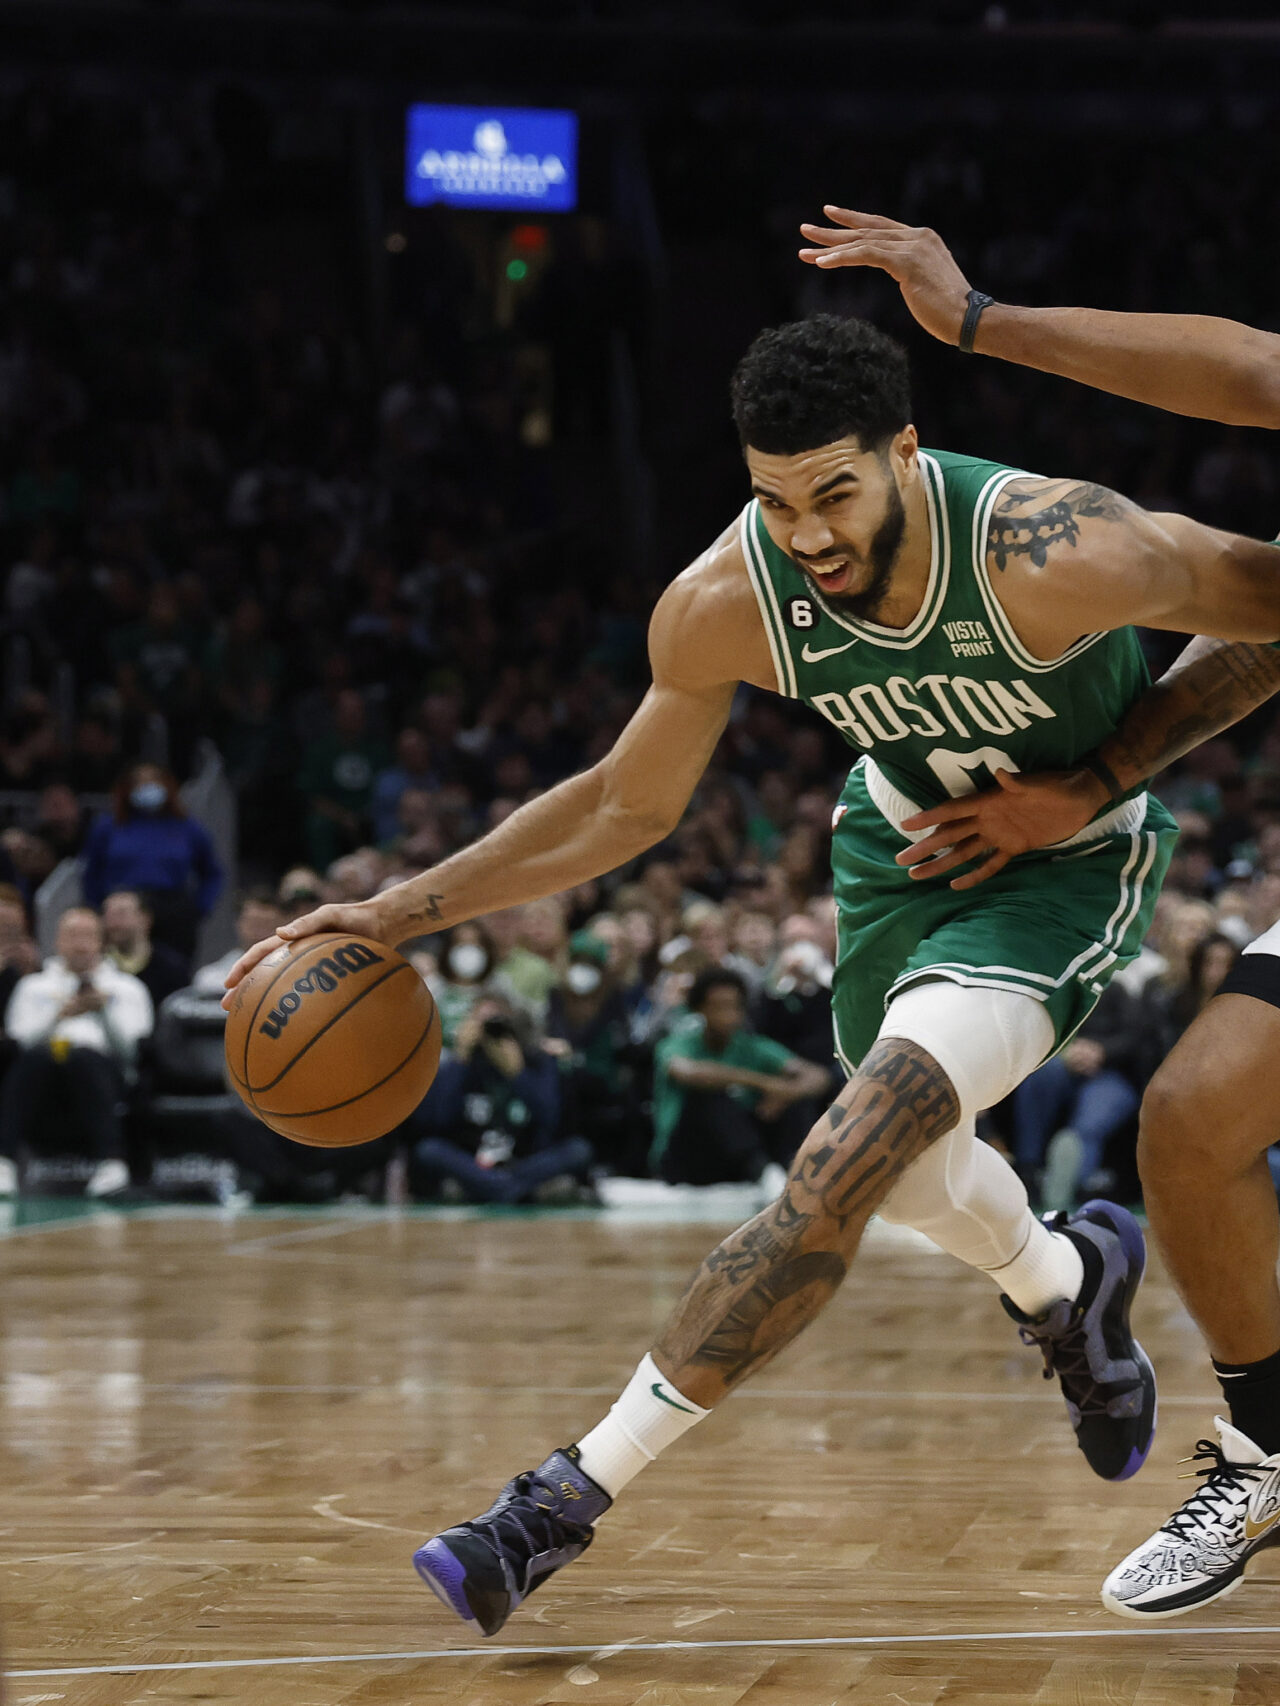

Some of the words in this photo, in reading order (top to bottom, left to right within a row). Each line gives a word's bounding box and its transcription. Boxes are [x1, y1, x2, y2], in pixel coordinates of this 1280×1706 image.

[790, 600, 813, 627] 6
[941, 620, 990, 643] VISTA
[950, 641, 995, 658] PRINT
[810, 674, 1057, 748] BOSTON
[259, 942, 385, 1040] Wilson
